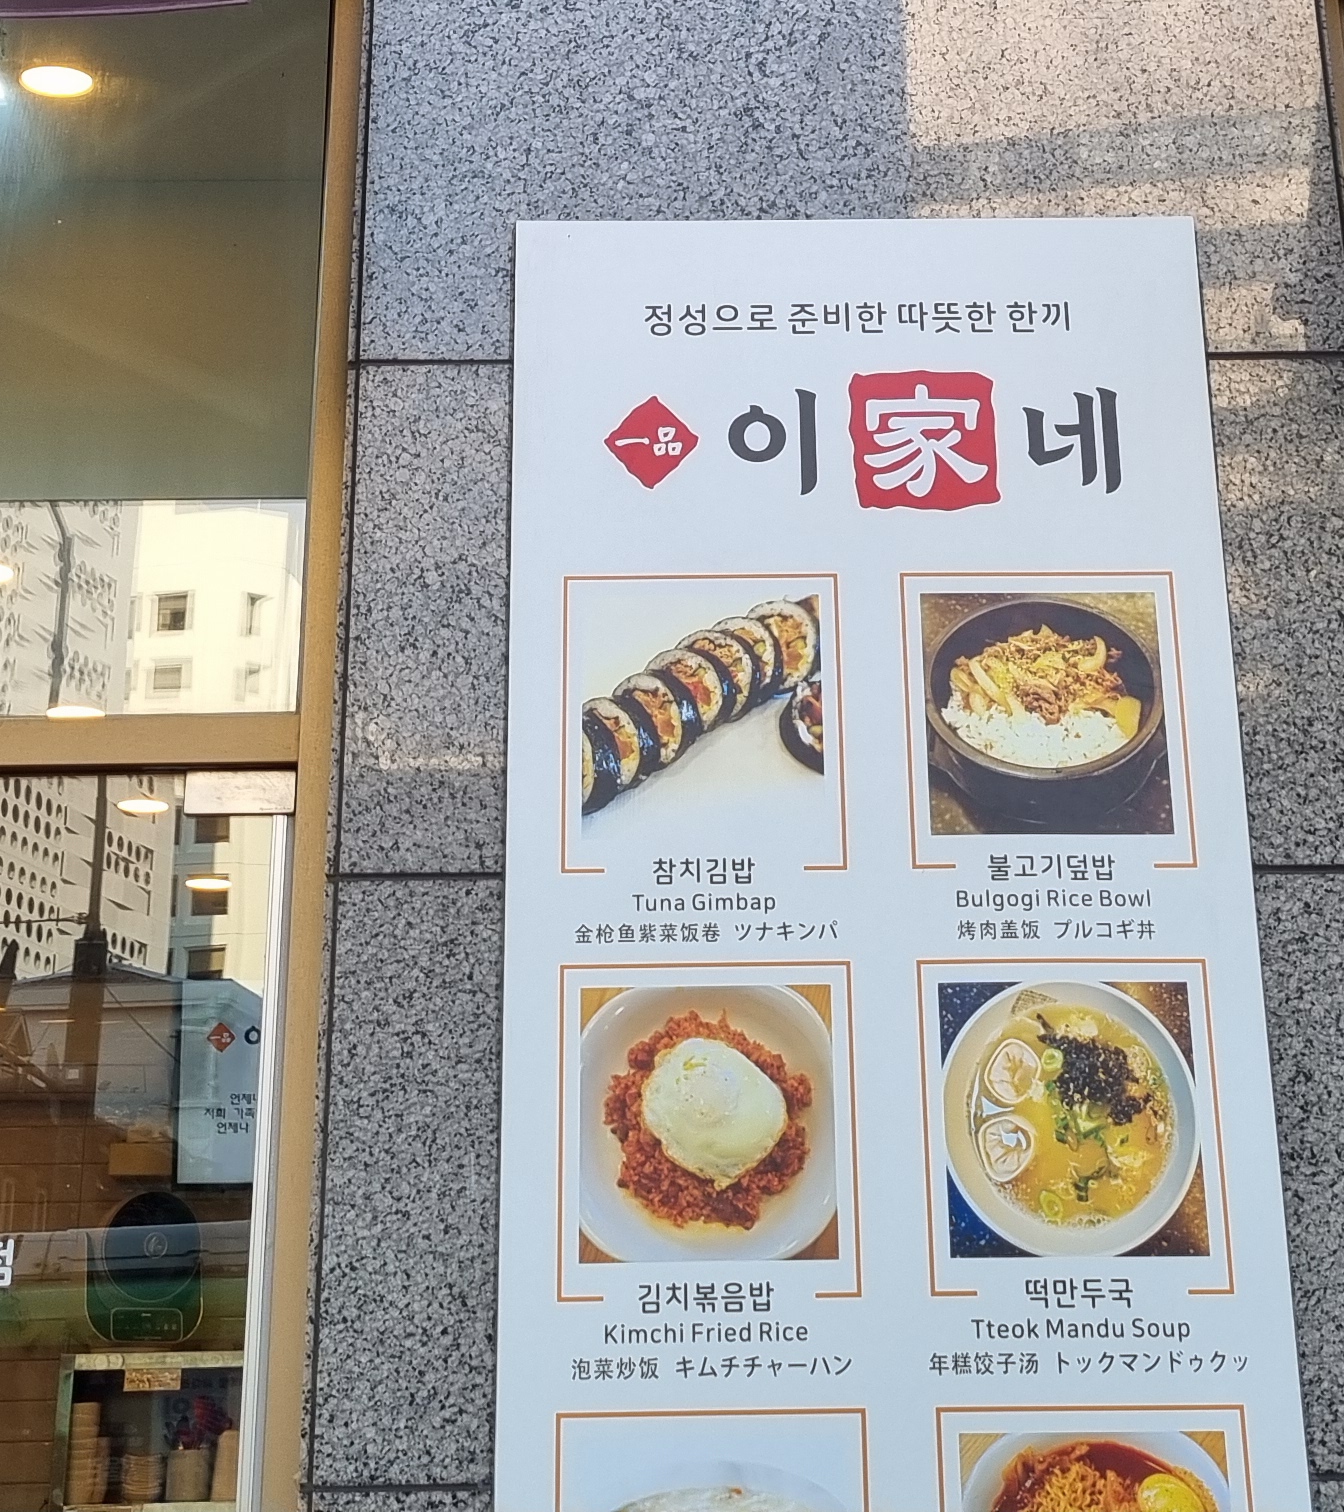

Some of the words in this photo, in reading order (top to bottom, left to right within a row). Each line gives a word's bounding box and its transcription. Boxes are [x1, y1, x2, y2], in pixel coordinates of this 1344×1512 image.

[644, 303, 778, 337] 정성으로
[787, 301, 887, 335] 준비한
[896, 301, 997, 334] 따뜻한
[1006, 300, 1072, 334] 한끼
[613, 426, 683, 458] 一品
[652, 857, 756, 885] 참치김밥
[987, 853, 1116, 881] 불고기덮밥
[632, 894, 685, 912] Tuna
[692, 892, 776, 914] Gimbap
[956, 889, 1041, 911] Bulgogi
[1047, 889, 1094, 907] Rice
[1099, 889, 1152, 908] Bowl
[574, 922, 721, 944] 金枪鱼紫菜饭卷
[734, 920, 840, 942] ツナキンパ
[957, 919, 1041, 940] 烤肉盖饭
[1054, 918, 1156, 940] プルコギ丼
[216, 1122, 249, 1135] 언제나
[637, 1281, 775, 1314] 김치볶음밥
[1025, 1278, 1134, 1309] 떡만두국
[604, 1322, 684, 1344] Kimchi
[691, 1322, 752, 1342] Fried
[759, 1321, 809, 1342] Rice
[971, 1318, 1040, 1339] Tteok
[1046, 1318, 1125, 1339] Mandu
[1131, 1317, 1191, 1342] Soup
[571, 1356, 660, 1381] 泡菜炒饭
[675, 1355, 853, 1379] キムチチャーハン
[928, 1351, 1039, 1376] 年糕饺子汤
[1056, 1350, 1249, 1374] トックマンドゥクッ
